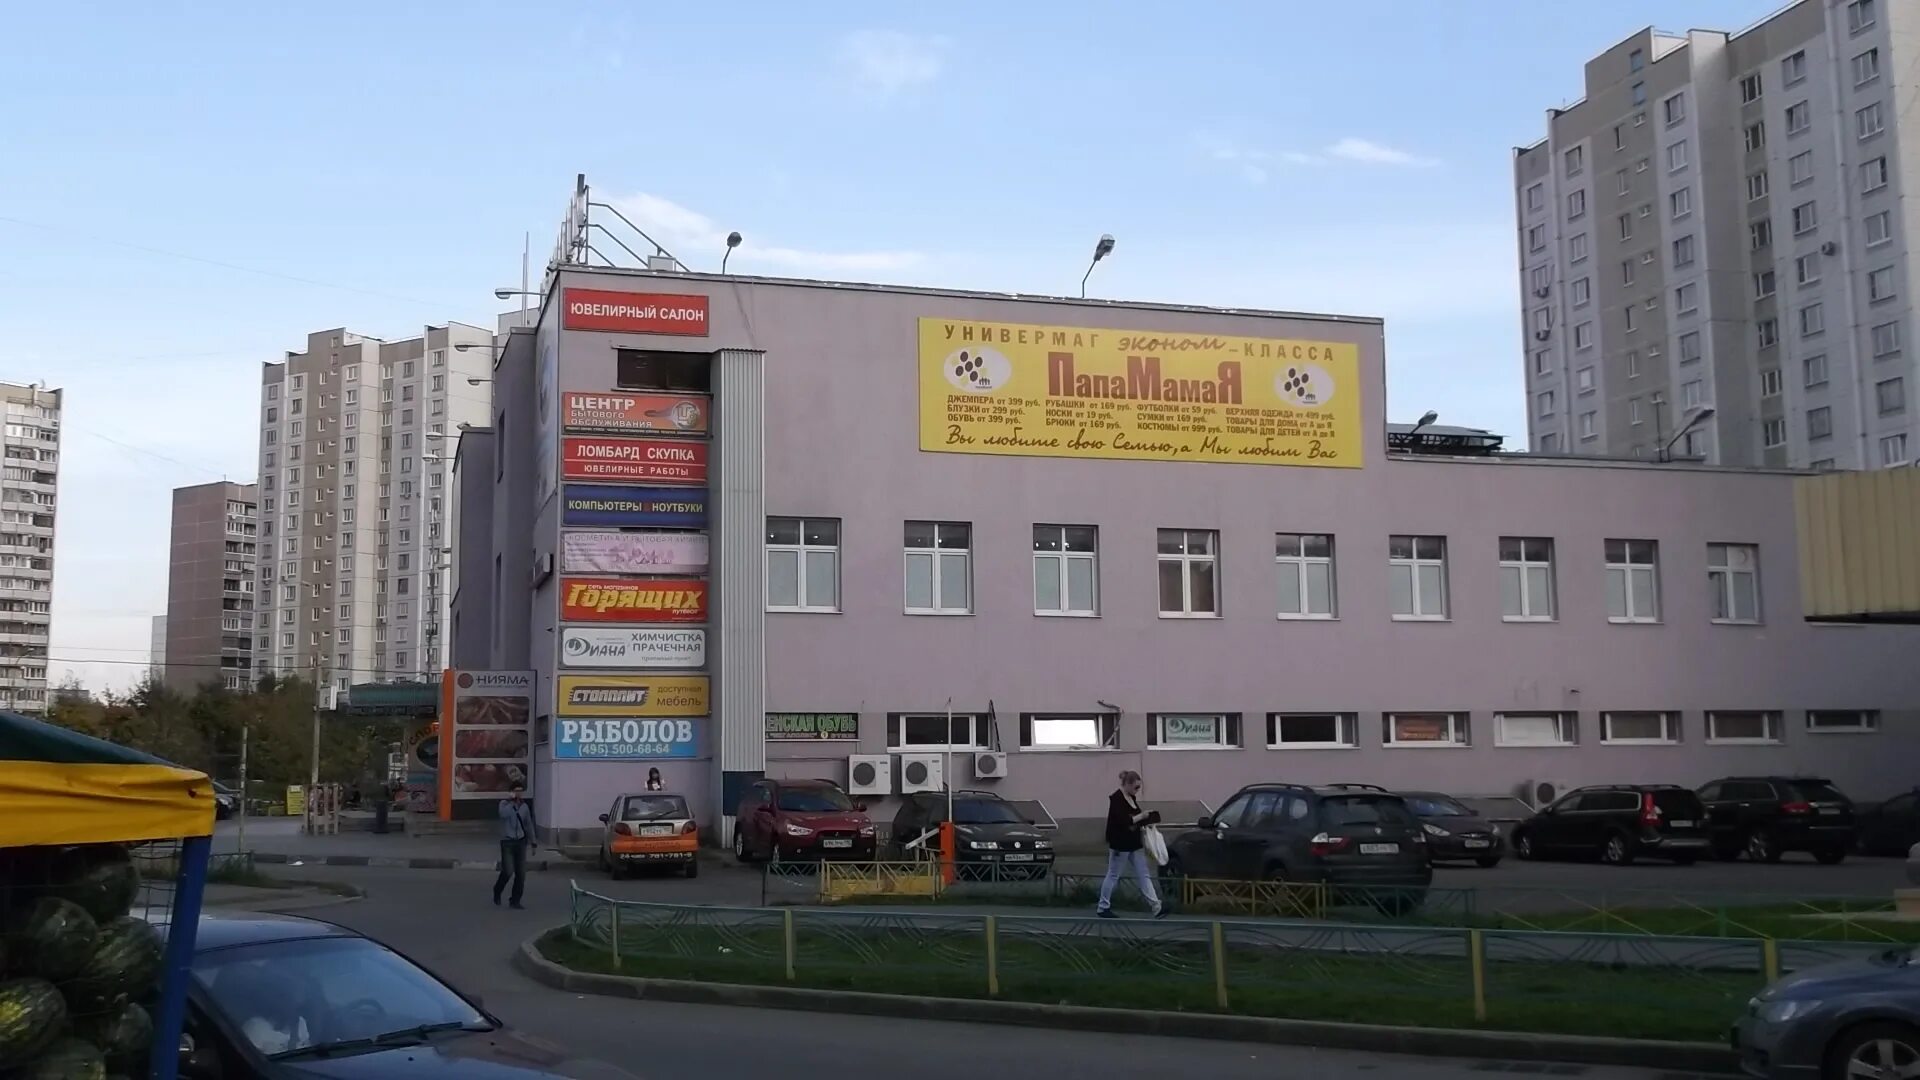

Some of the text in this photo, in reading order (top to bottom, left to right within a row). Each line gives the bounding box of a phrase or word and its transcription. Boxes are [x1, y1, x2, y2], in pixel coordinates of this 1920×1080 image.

[571, 303, 704, 322] ЮВЕЛИРНЫЙ САЛОН
[944, 324, 1100, 348] УНИВЕРМАГ
[571, 397, 636, 411] ЦЕНТР
[947, 395, 994, 405] ДЖЕМПЕРА
[1008, 397, 1023, 406] 399
[1025, 399, 1040, 407] руб.
[1045, 400, 1085, 409] РУБАШКИ
[1101, 402, 1115, 410] 169
[1116, 403, 1132, 411] руб.
[571, 410, 625, 419] БЫТОВОГО
[947, 404, 980, 413] БЛУЗКИ
[992, 406, 1008, 414] 299
[1010, 408, 1026, 416] руб.
[1045, 409, 1073, 417] НОСКИ
[1098, 412, 1113, 420] руб.
[1136, 403, 1180, 413] ФУТБОЛКИ
[1192, 405, 1201, 413] 59
[1203, 407, 1217, 415] руб.
[1225, 408, 1260, 417] ВЕРХНЯЯ
[1261, 409, 1294, 418] ОДЕЖДА
[570, 418, 652, 428] ОБСЛУЖИВАНИЯ
[947, 413, 975, 422] ОБУВЬ
[988, 415, 1003, 423] 399
[1005, 416, 1021, 424] руб.
[1045, 418, 1075, 427] БРЮКИ
[1090, 420, 1105, 428] 169
[1106, 421, 1121, 429] руб.
[1137, 413, 1165, 421] СУМКИ
[1177, 414, 1191, 422] 169
[1193, 415, 1207, 423] руб.
[1225, 416, 1257, 425] ТОВАРЫ
[1259, 418, 1275, 427] ДЛЯ
[1277, 418, 1298, 427] ДОМА
[1137, 422, 1179, 431] КОСТЮМЫ
[1208, 426, 1223, 434] руб.
[1226, 426, 1258, 434] ТОВАРЫ
[1259, 427, 1275, 436] ДЛЯ
[945, 424, 976, 445] Вы
[983, 426, 1060, 449] любите
[1067, 428, 1106, 450] свою
[1200, 436, 1231, 454] Мы
[1238, 438, 1302, 457] любим
[1306, 440, 1338, 459] Вас
[577, 445, 695, 461] ЛОМБАРД СКУПКА
[584, 465, 689, 476] ЮВЕЛИРНЫЕ РАБОТЫ
[568, 500, 642, 512] КОМПЬЮТЕРЫ
[652, 502, 703, 513] НОУТБУКИ
[631, 633, 702, 642] ХИМЧИСТКА
[632, 643, 701, 652] ПРАЧЕЧНАЯ
[476, 675, 530, 685] НИЯМА
[572, 689, 646, 703] СТОЛПЛИТ
[656, 697, 702, 706] мебель
[765, 714, 857, 732] ЕНСКАЯ ОБУВЬ
[561, 720, 693, 744] РЫБОЛОВ
[578, 744, 670, 757] (495) 500-68-64
